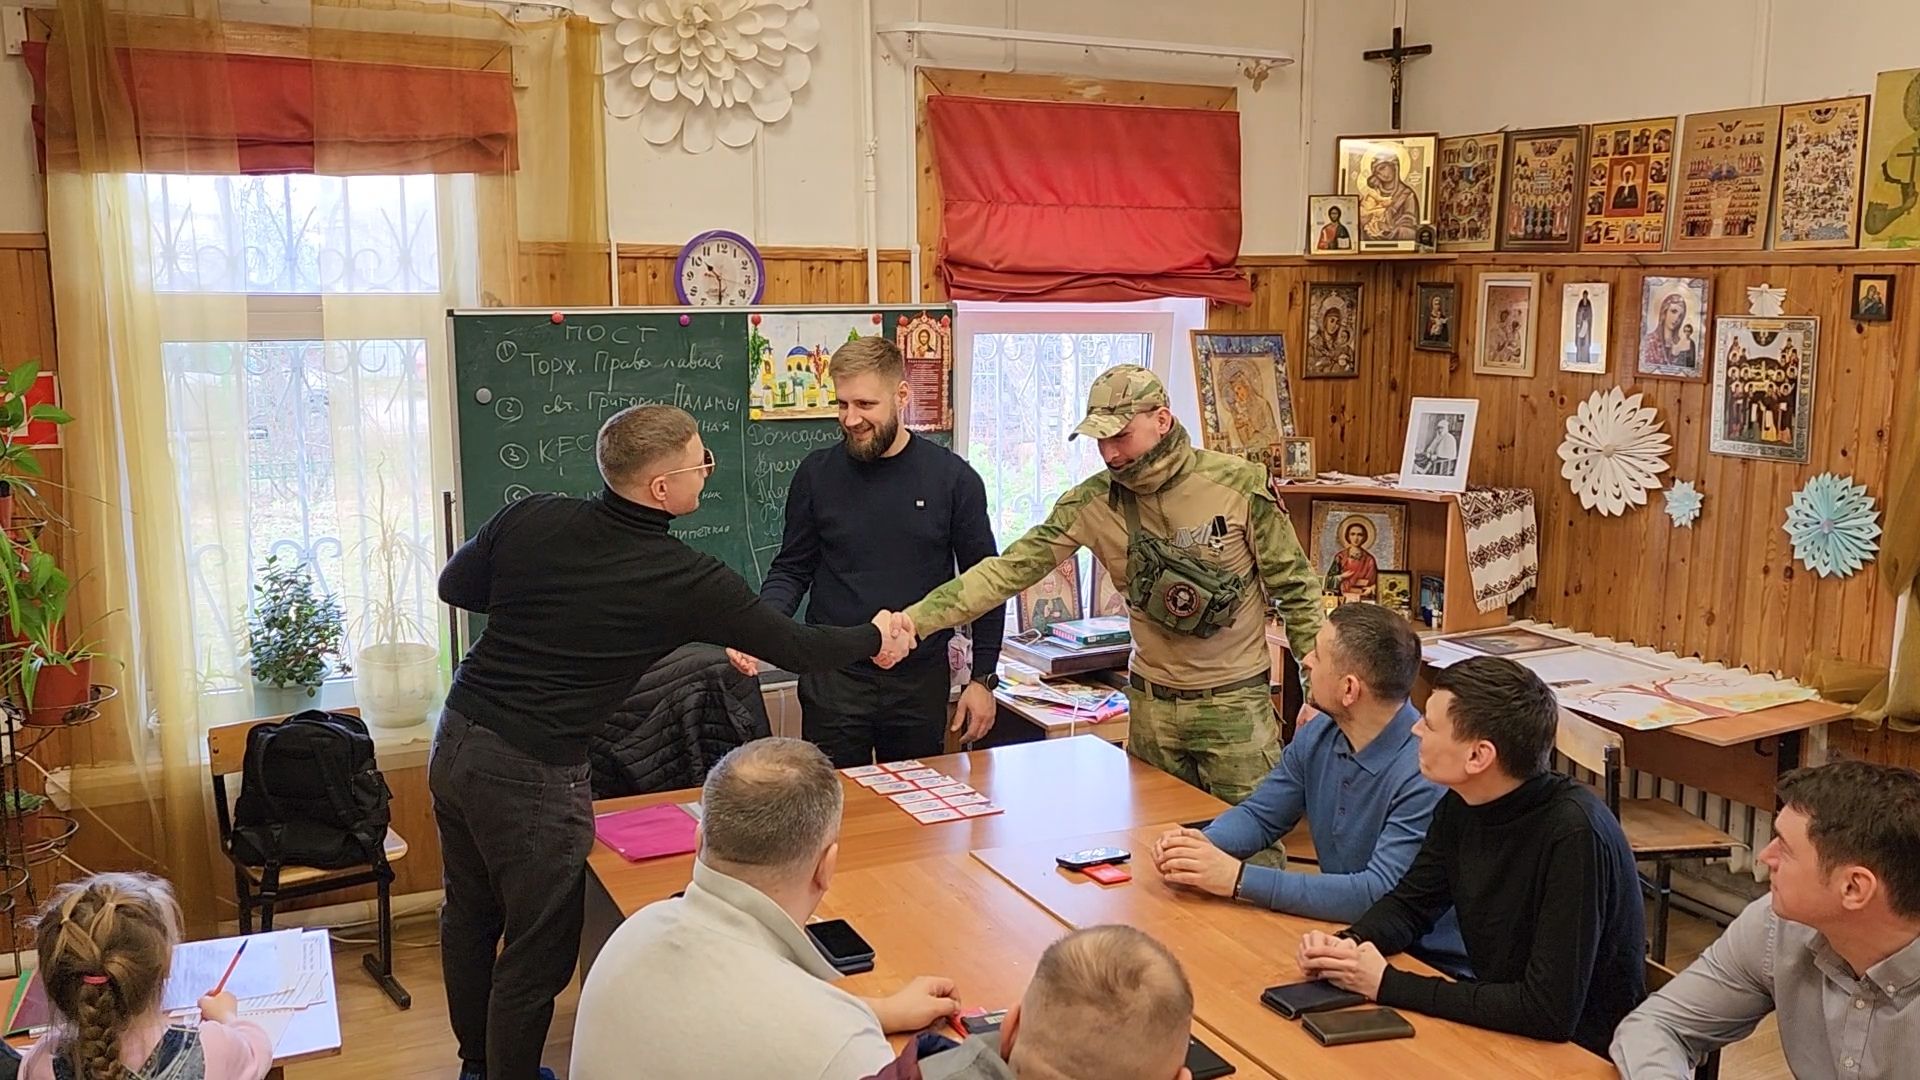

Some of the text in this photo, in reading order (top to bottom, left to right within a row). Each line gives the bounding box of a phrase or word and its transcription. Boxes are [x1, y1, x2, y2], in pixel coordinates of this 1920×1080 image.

[703, 246, 711, 256] 11
[716, 243, 728, 254] 12
[691, 256, 703, 267] 10
[741, 260, 748, 270] 2
[686, 270, 694, 281] 9
[744, 274, 752, 285] 3
[690, 285, 698, 296] 8
[738, 288, 746, 299] 4
[700, 297, 707, 306] 7
[564, 325, 658, 344] ПОСТ
[521, 351, 583, 392] Торж.
[746, 423, 846, 451] Рождеств
